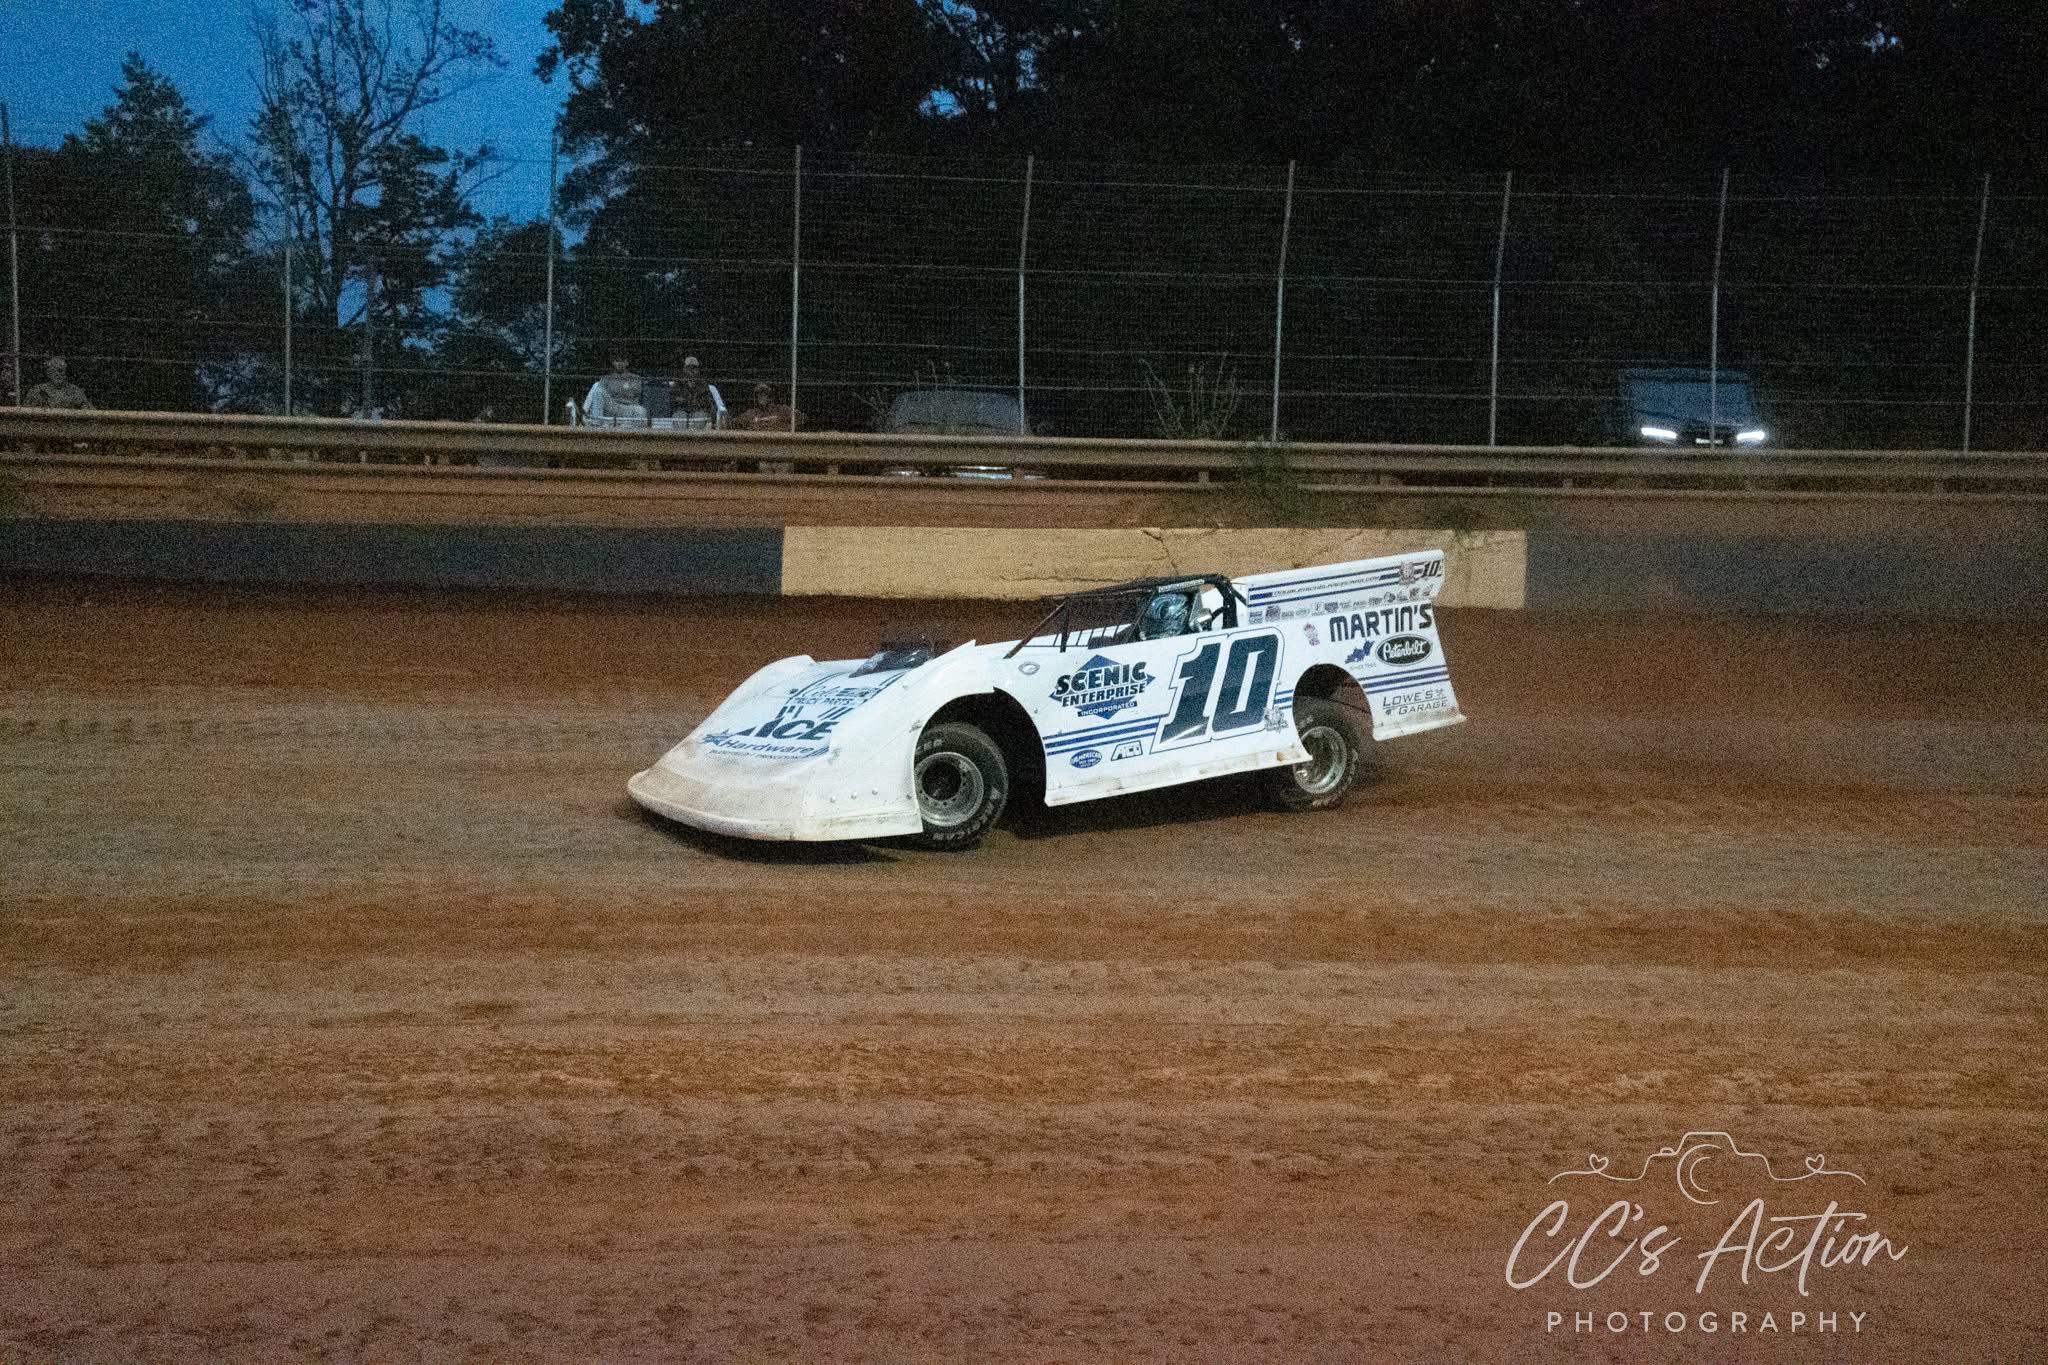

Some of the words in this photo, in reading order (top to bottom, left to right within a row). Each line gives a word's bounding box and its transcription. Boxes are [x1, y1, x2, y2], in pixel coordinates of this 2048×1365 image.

[1329, 602, 1433, 642] MARTIN'S
[1382, 640, 1429, 661] Peterbilt
[1055, 661, 1147, 695] SCENIC
[1157, 631, 1281, 746] 10
[1062, 683, 1146, 707] ENTERPRISE
[1080, 702, 1136, 716] INCORPORATED
[1398, 700, 1449, 716] GARAGE
[736, 718, 840, 741] ACE
[719, 740, 815, 753] Hardware
